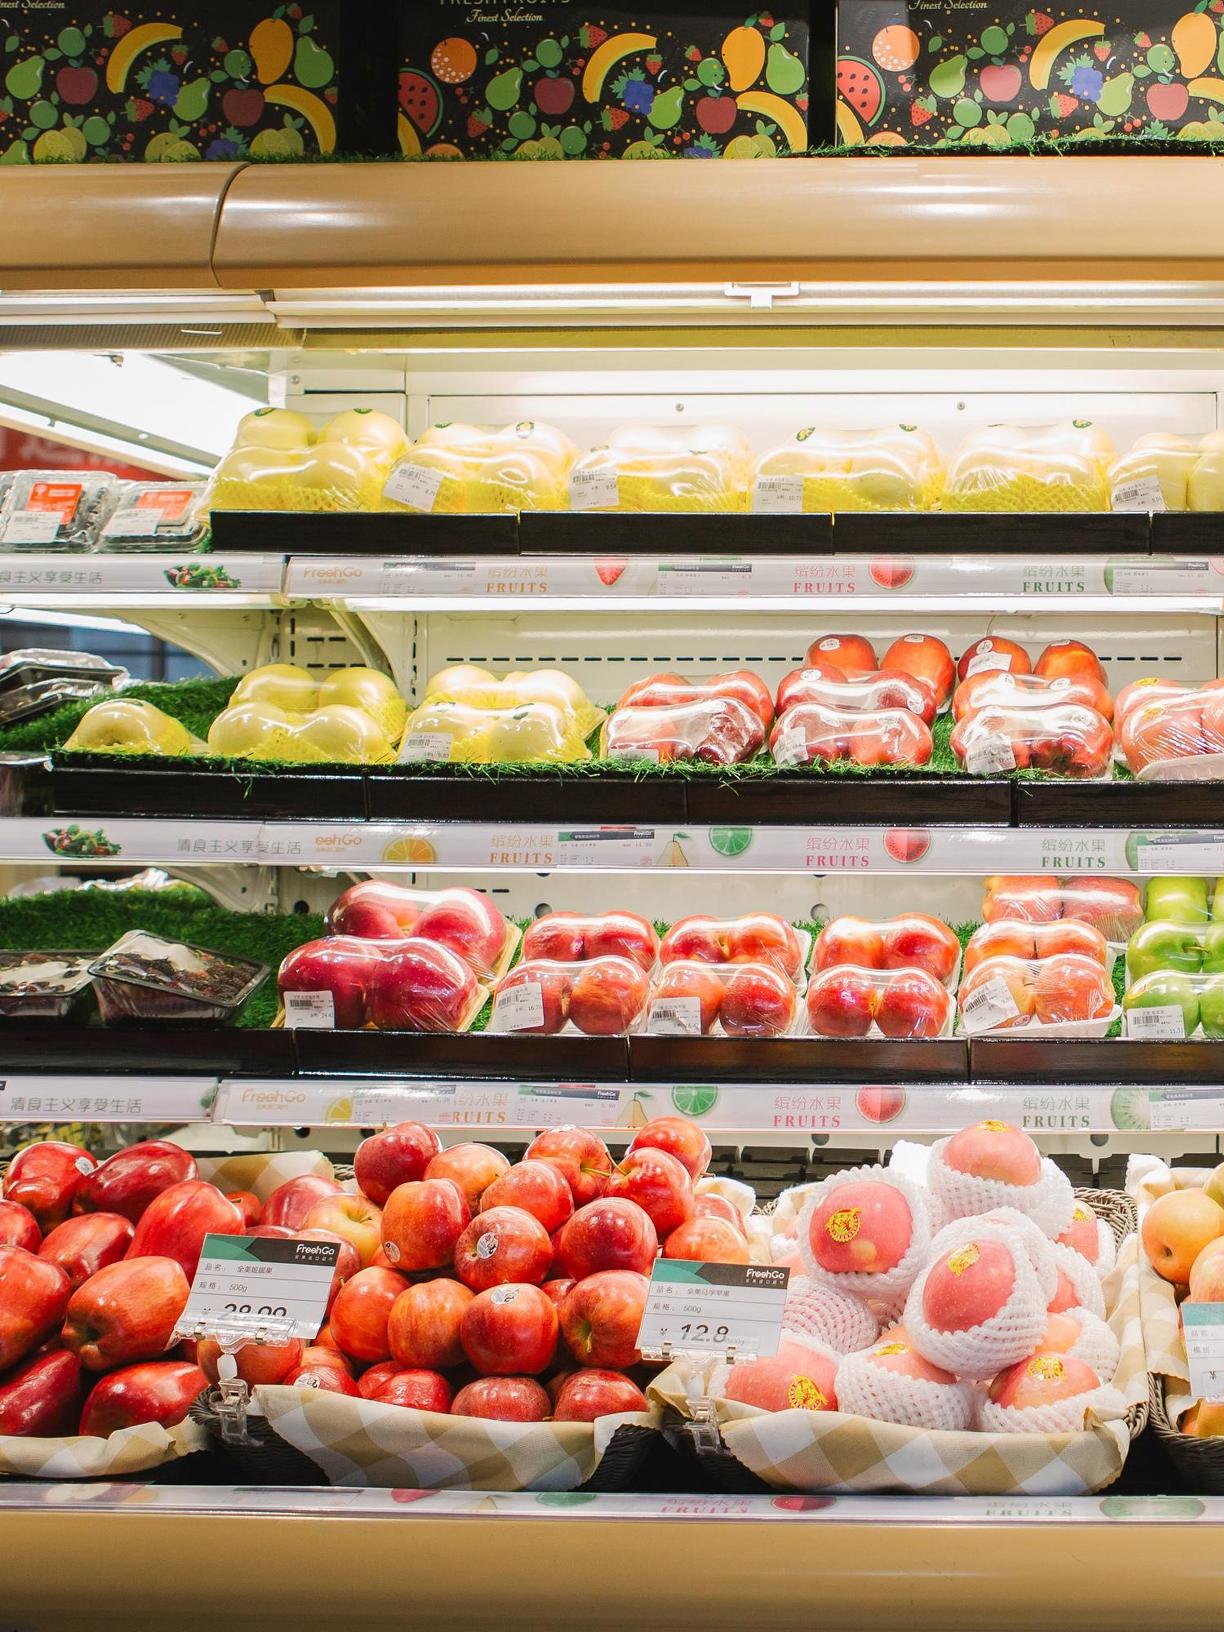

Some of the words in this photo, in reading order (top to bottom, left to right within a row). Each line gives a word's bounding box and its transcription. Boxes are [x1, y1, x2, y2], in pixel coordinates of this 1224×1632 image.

[909, 0, 941, 10] Finest
[944, 0, 988, 10] Selection
[466, 8, 499, 23] Finest
[501, 6, 544, 22] Selection
[486, 583, 549, 594] FRUITS
[793, 582, 856, 593] FRUITS
[1022, 581, 1086, 593] FRUITS
[489, 852, 553, 864] FRUITS
[805, 855, 870, 867] FRUITS
[1041, 856, 1106, 869] FRUITS
[773, 1115, 841, 1128] FRUITS
[1021, 1114, 1091, 1128] FRUITS
[295, 1243, 336, 1256] FreshGo
[745, 1268, 785, 1280] FreshGo
[679, 1323, 729, 1344] 12.8
